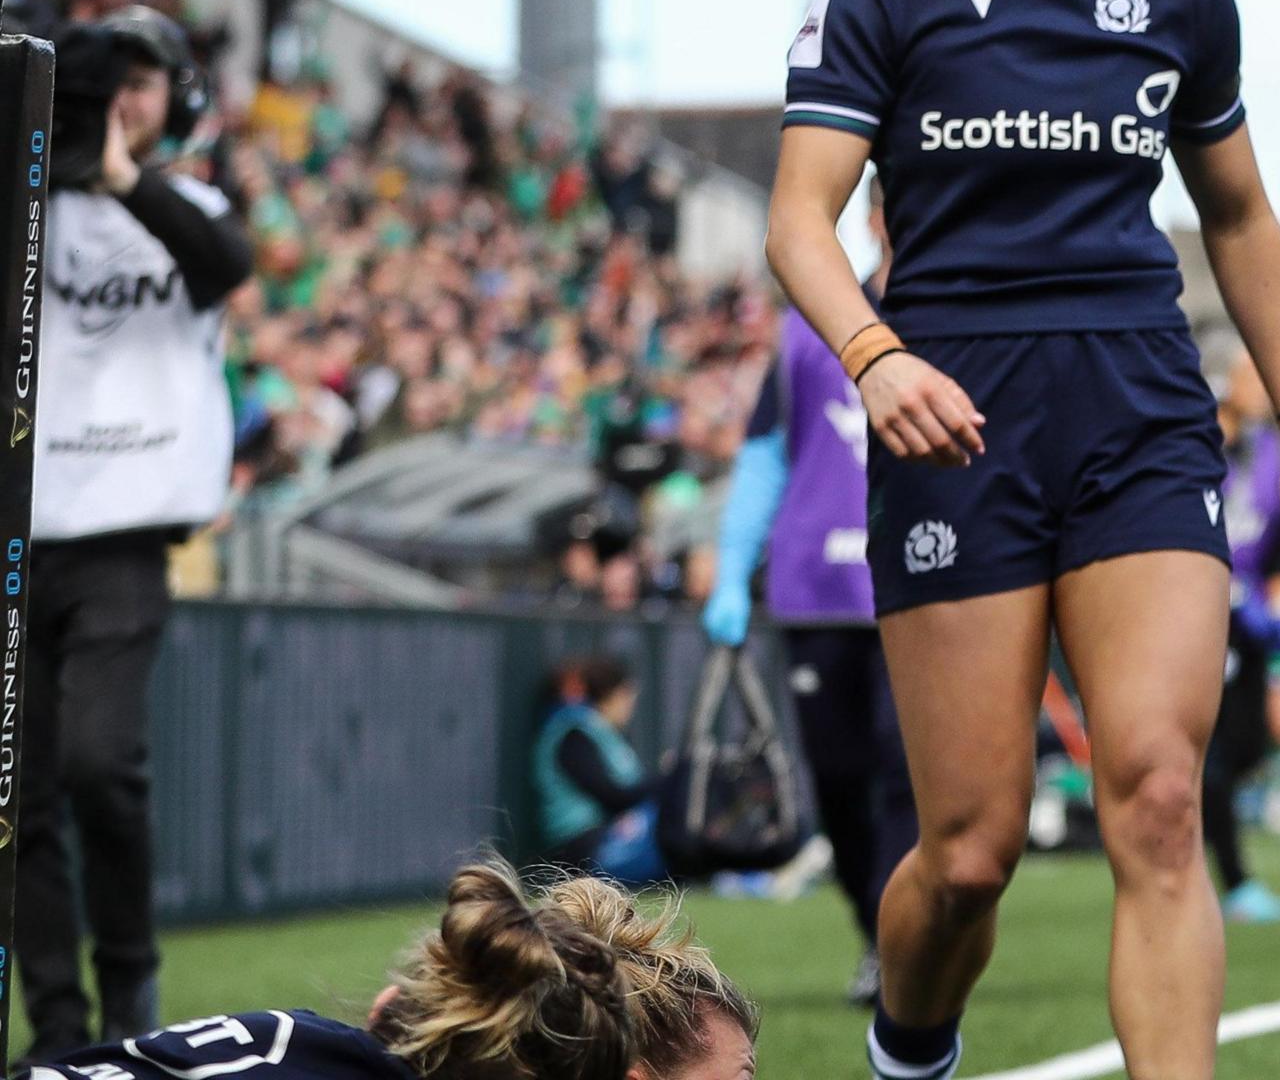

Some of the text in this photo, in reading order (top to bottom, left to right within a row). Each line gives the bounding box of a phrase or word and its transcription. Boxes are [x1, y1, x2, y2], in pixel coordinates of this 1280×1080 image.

[16, 130, 44, 399] GUINNESS 0.0
[920, 110, 1166, 160] Scottish Gas
[0, 538, 24, 807] GUINNESS 0.0
